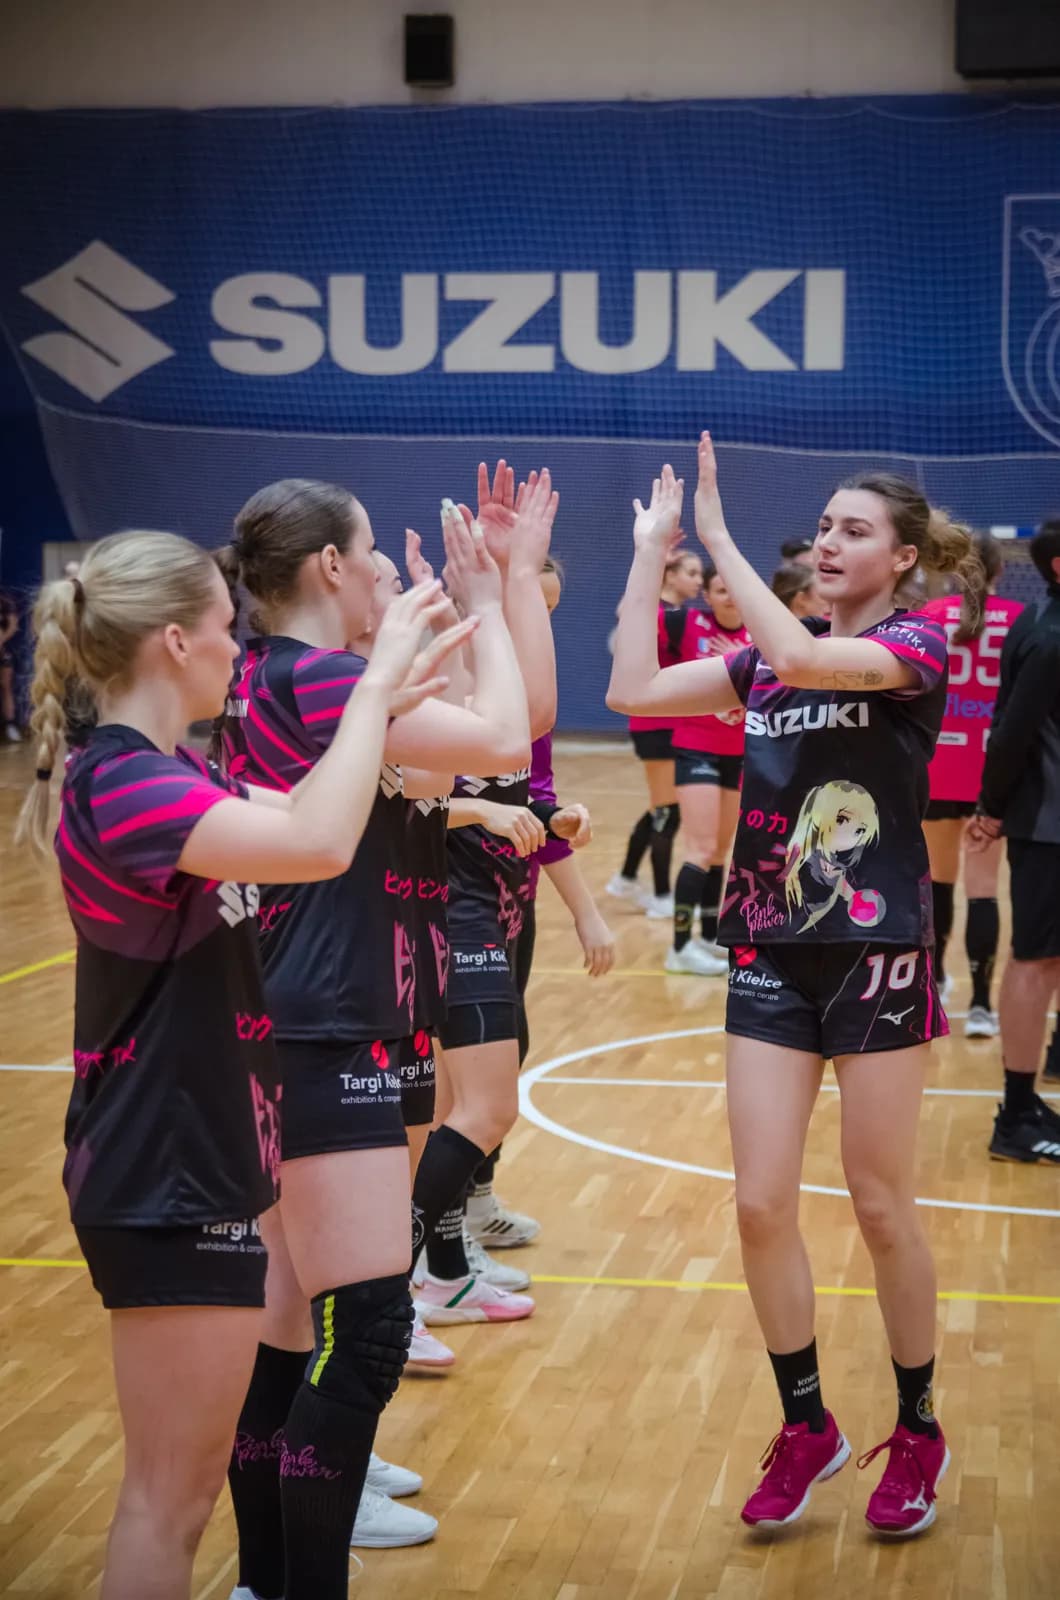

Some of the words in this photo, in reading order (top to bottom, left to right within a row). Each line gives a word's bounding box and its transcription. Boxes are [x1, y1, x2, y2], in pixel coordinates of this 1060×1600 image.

[209, 268, 846, 376] SUZUKI
[744, 702, 870, 738] SUZUKI
[738, 807, 789, 835] の力
[740, 893, 777, 924] Pink
[453, 949, 488, 966] Targi
[736, 969, 783, 989] Kielce
[860, 951, 920, 1001] 10
[340, 1072, 382, 1094] Targi
